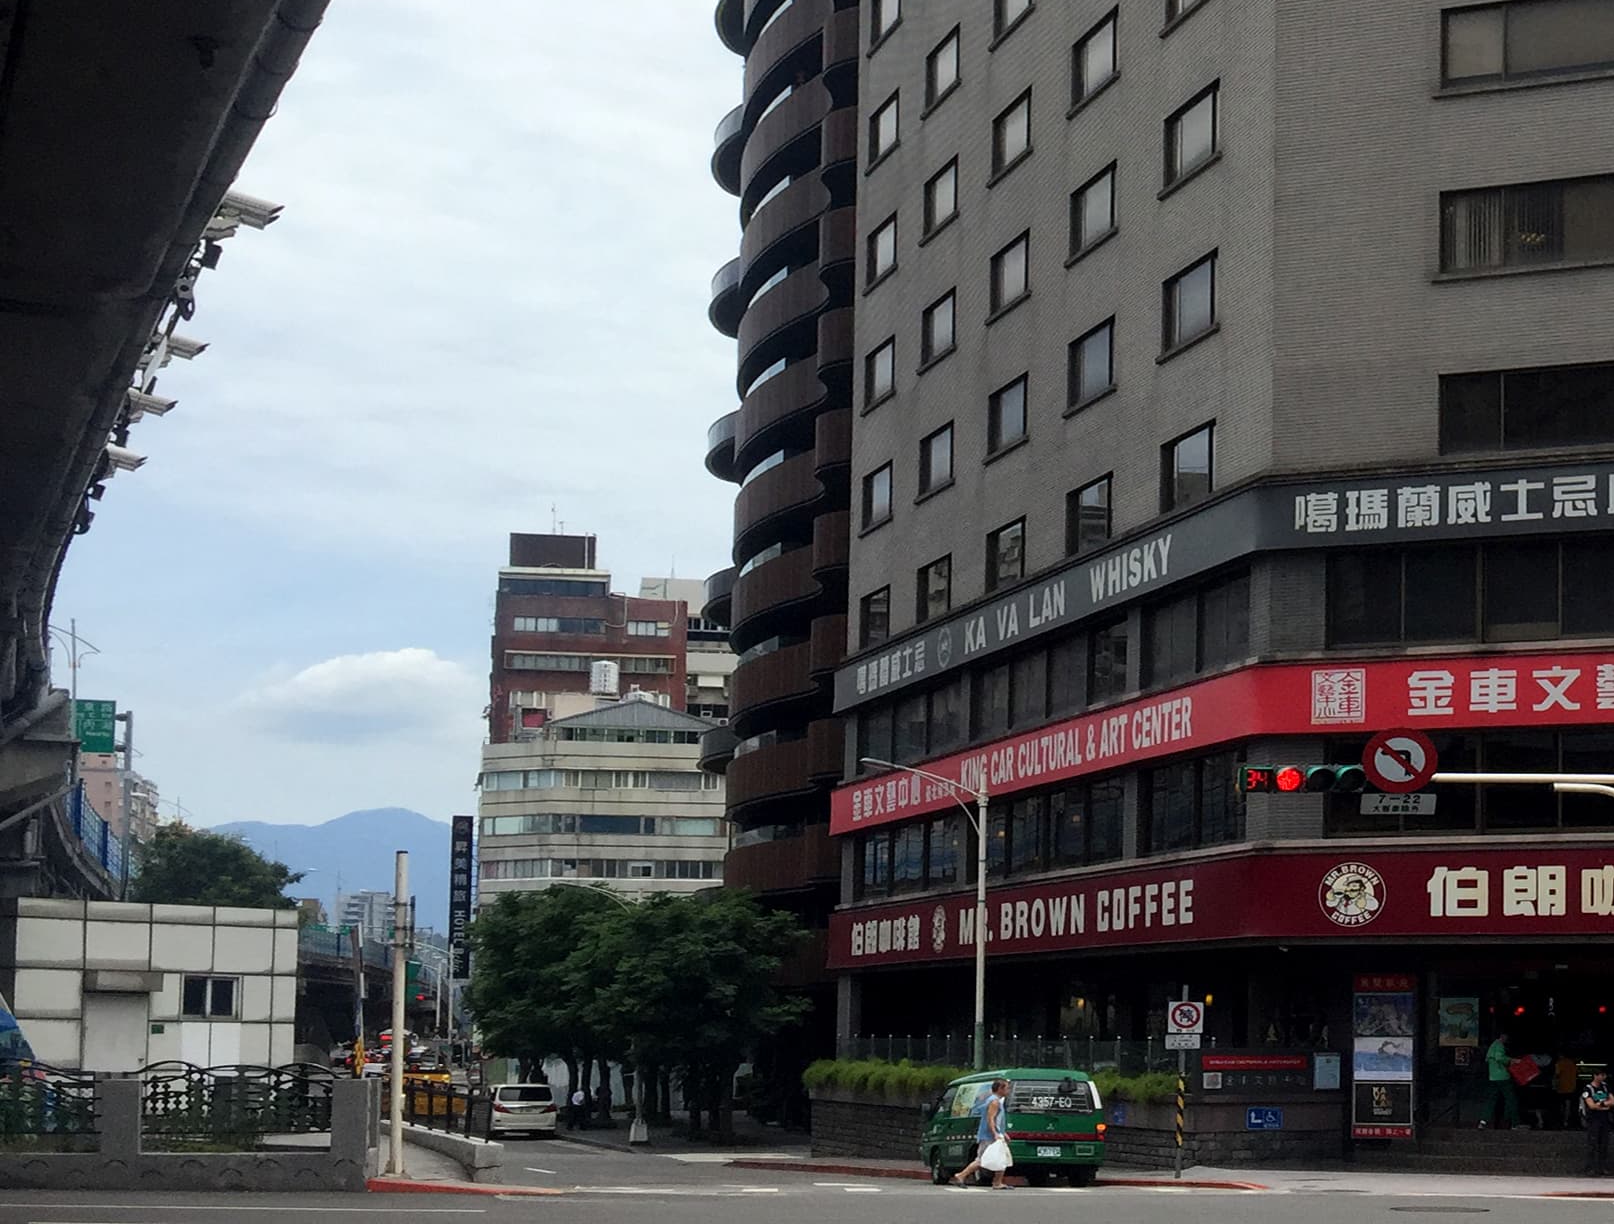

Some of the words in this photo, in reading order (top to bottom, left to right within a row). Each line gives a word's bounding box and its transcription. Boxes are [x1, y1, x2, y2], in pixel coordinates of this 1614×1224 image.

[1090, 534, 1172, 603] WHISKY
[991, 747, 1014, 785] CAR
[1017, 727, 1082, 778] CULTURAL
[1086, 724, 1096, 760] &
[1099, 714, 1128, 759] ART
[1132, 697, 1192, 750] CENTER
[453, 910, 465, 944] HOTEL
[1000, 893, 1086, 941] BROWN
[1097, 879, 1194, 932] COFFEE
[1331, 910, 1372, 925] COFFEE
